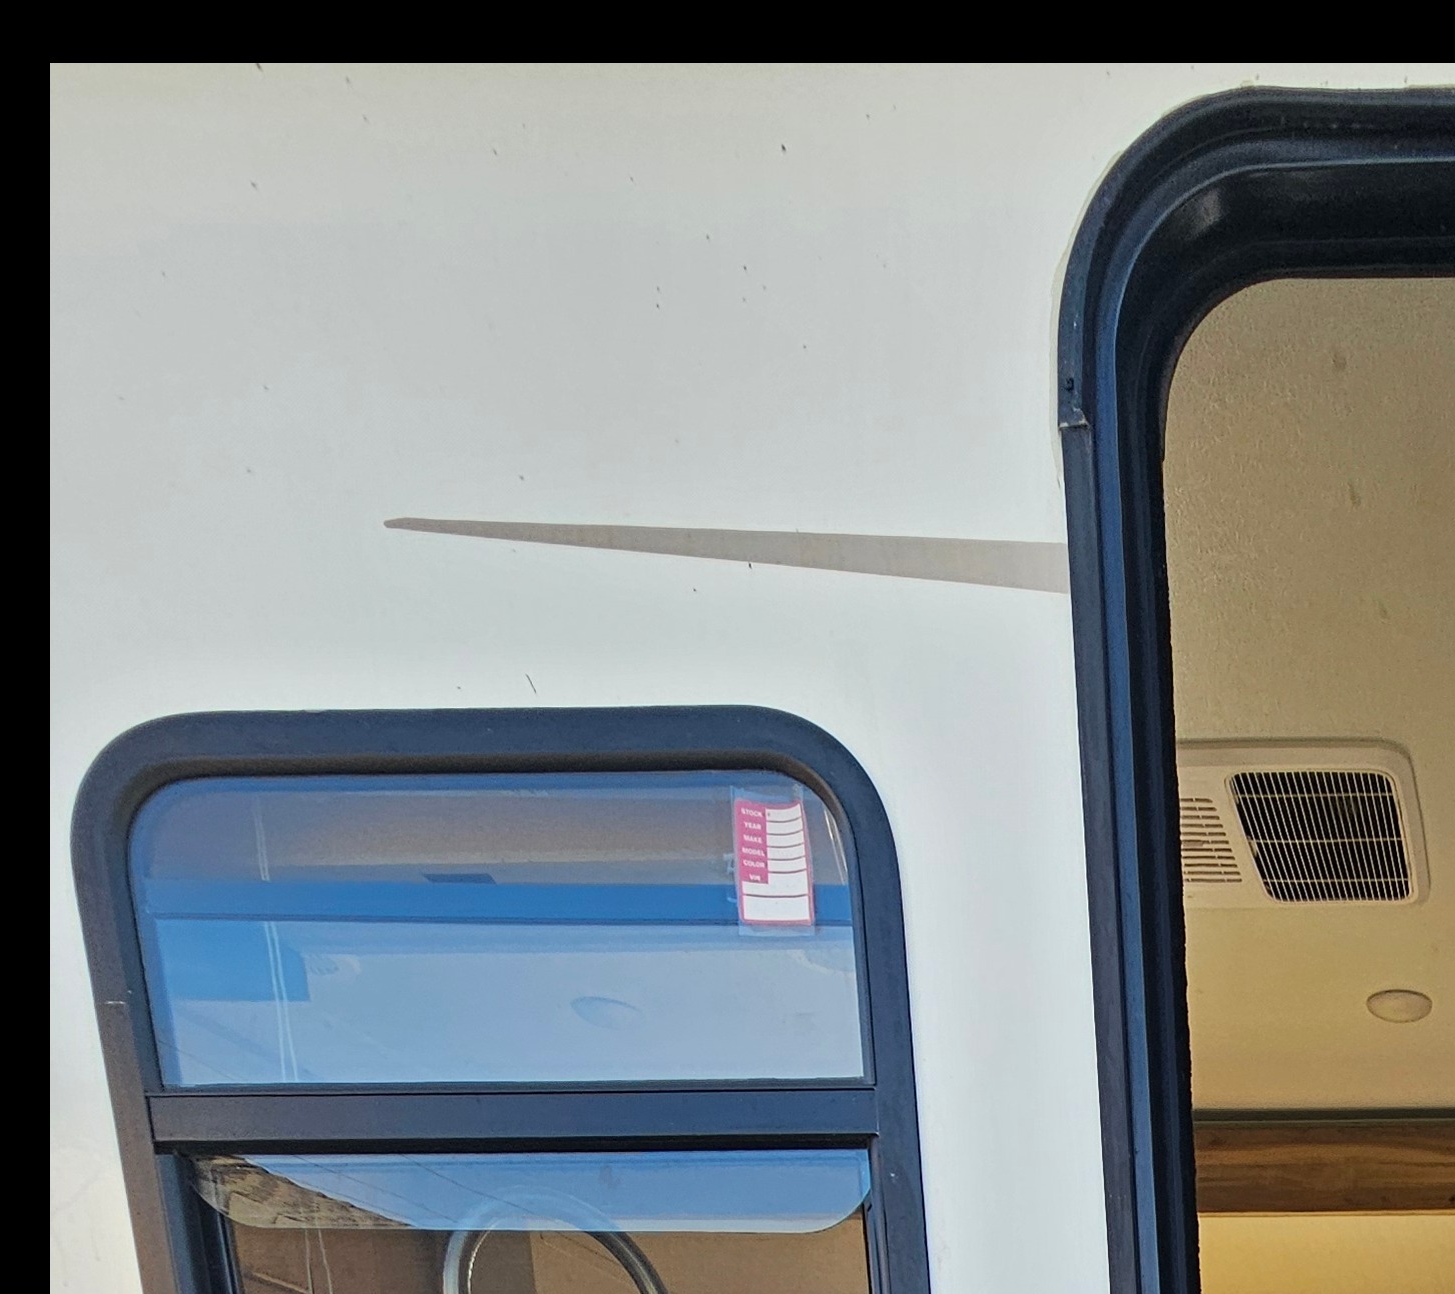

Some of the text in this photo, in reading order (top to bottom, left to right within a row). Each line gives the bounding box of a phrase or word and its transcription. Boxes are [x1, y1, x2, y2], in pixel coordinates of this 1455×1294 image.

[743, 822, 762, 830] YEAR
[743, 834, 762, 843] MAKE
[742, 847, 765, 857] MODEL
[742, 859, 765, 868] COLOR
